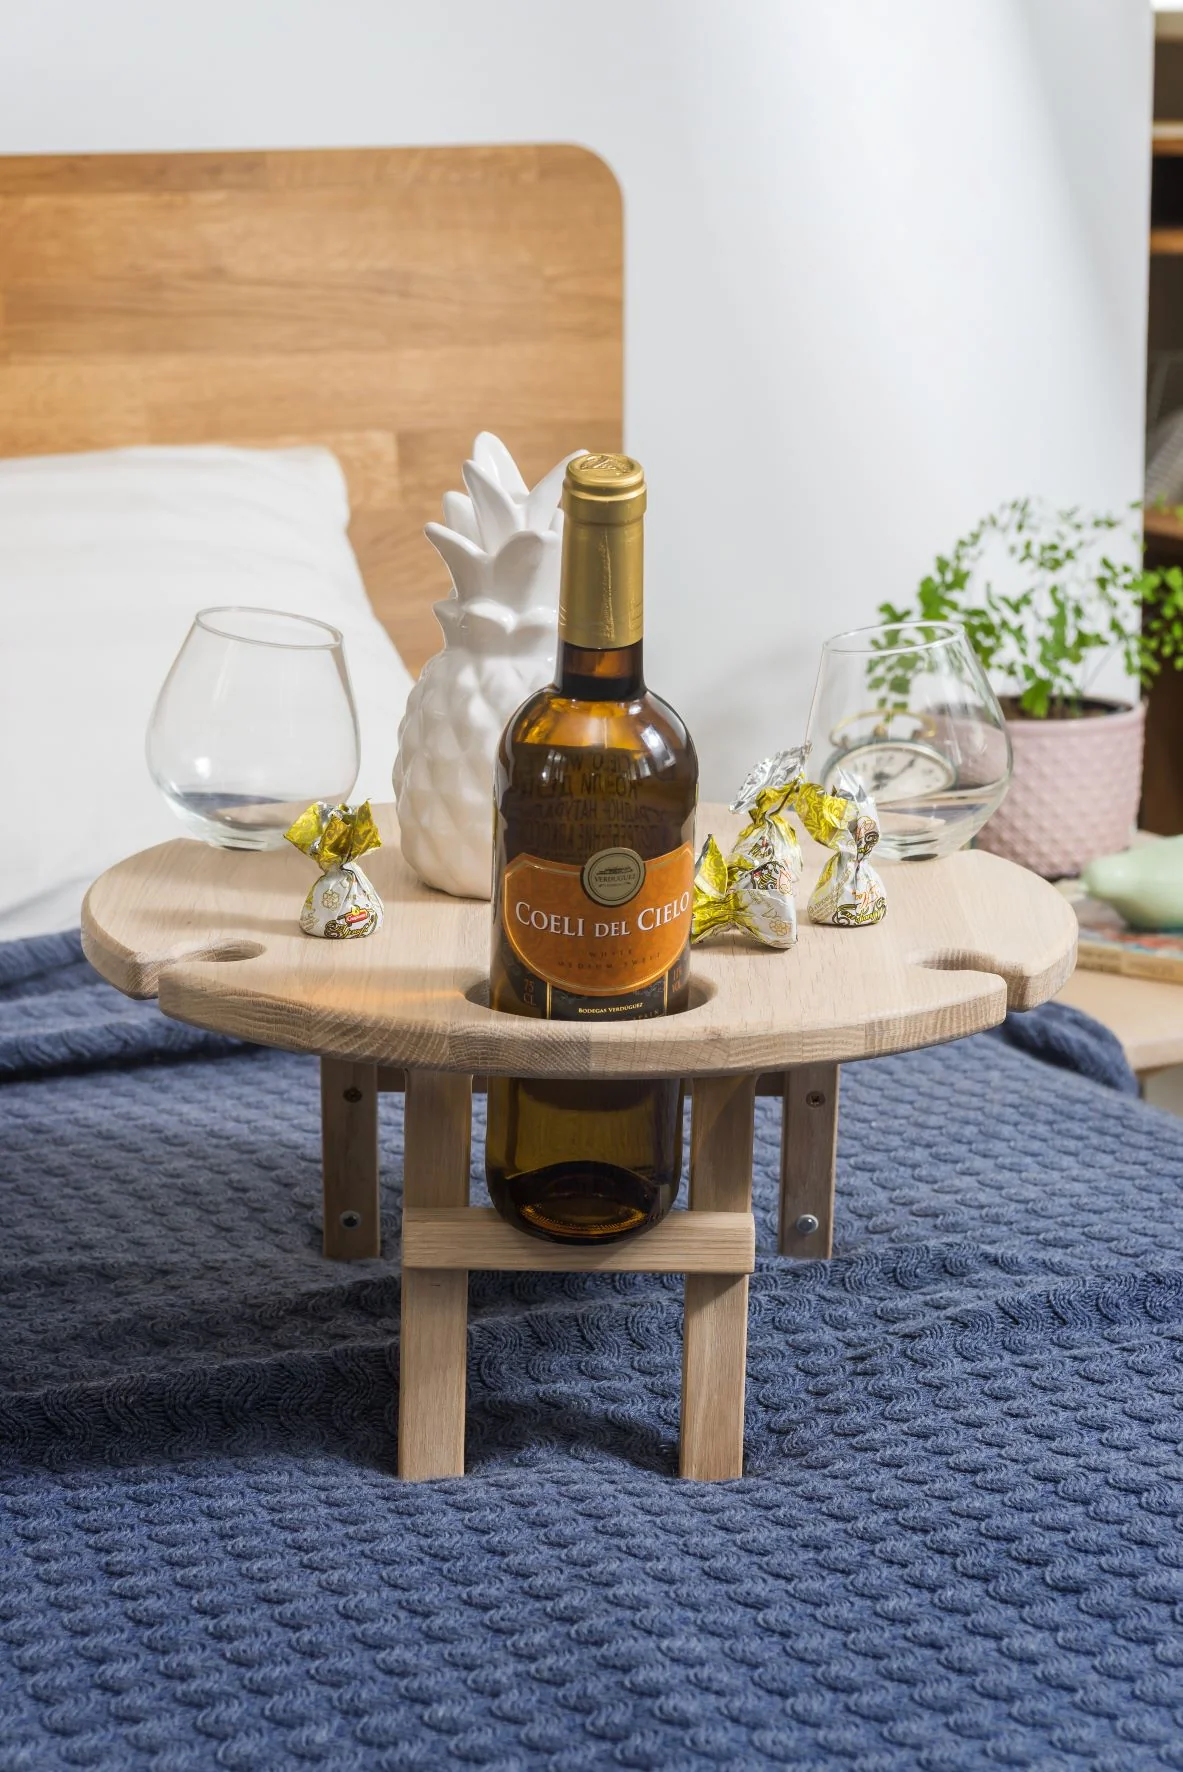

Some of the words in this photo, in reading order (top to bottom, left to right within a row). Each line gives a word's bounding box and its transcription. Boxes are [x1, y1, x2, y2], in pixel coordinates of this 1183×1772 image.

[515, 901, 585, 936] COELI
[595, 921, 631, 937] DEL
[637, 891, 690, 931] CIELO
